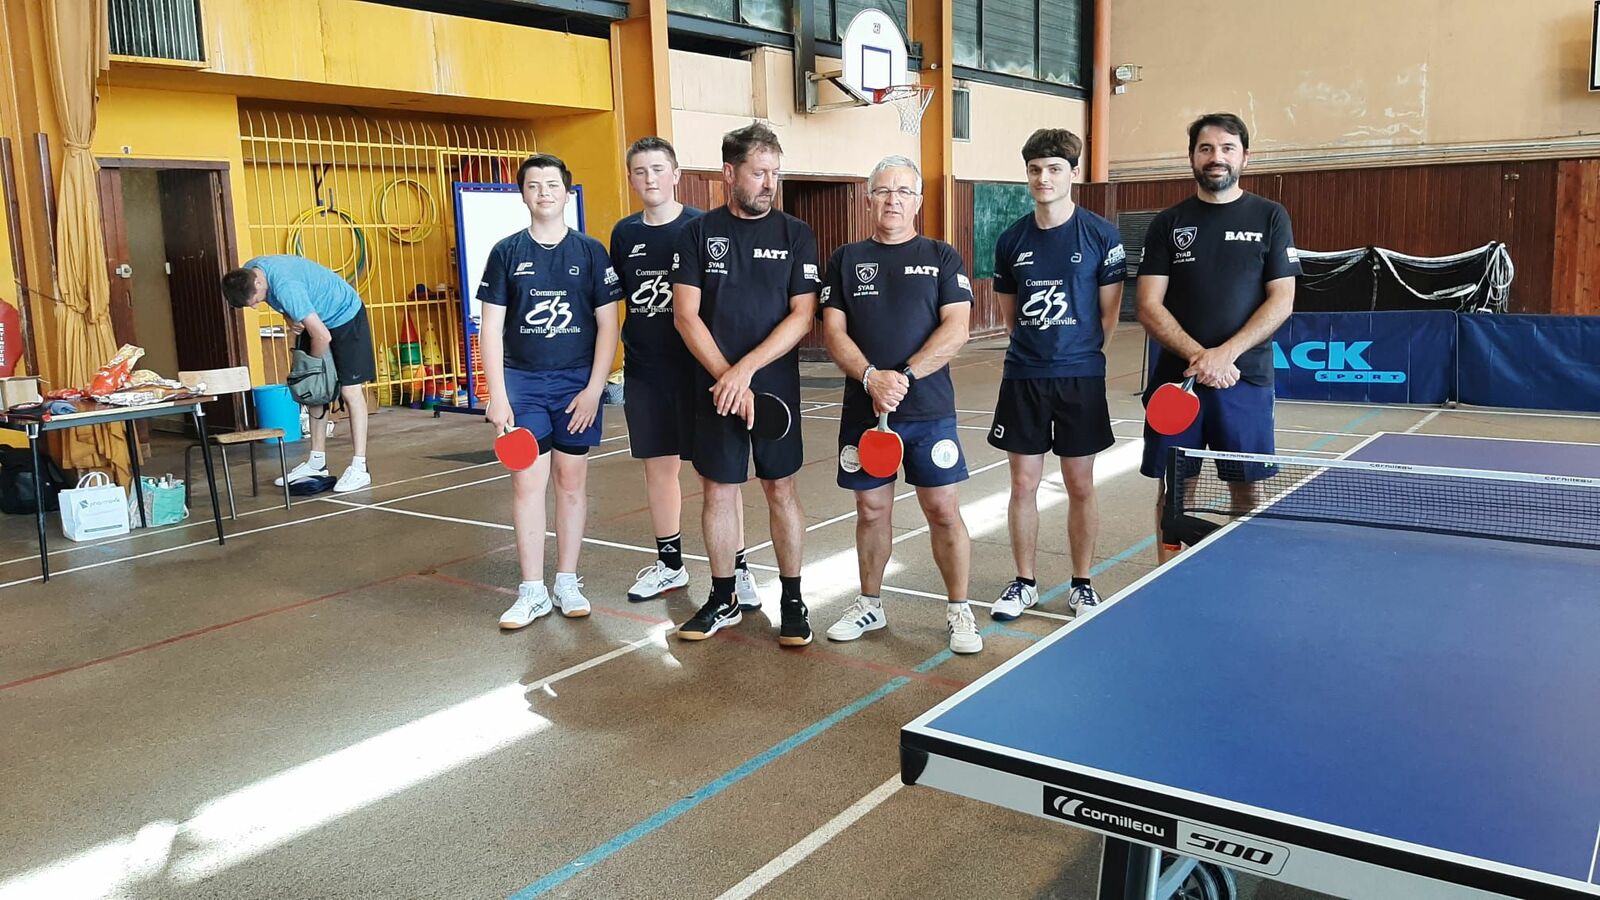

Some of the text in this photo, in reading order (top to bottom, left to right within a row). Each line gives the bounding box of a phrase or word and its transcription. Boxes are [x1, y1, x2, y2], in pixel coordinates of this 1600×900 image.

[1225, 231, 1263, 242] BATT
[753, 248, 788, 260] BATT
[1175, 251, 1191, 259] SYAB
[708, 261, 725, 269] SYAB
[904, 265, 940, 277] BATT
[1025, 279, 1064, 287] Commune
[529, 289, 568, 297] Commune
[1043, 317, 1077, 326] Bienville
[519, 325, 582, 334] Eurville Bienville
[1081, 807, 1274, 865] cornilleau 500
